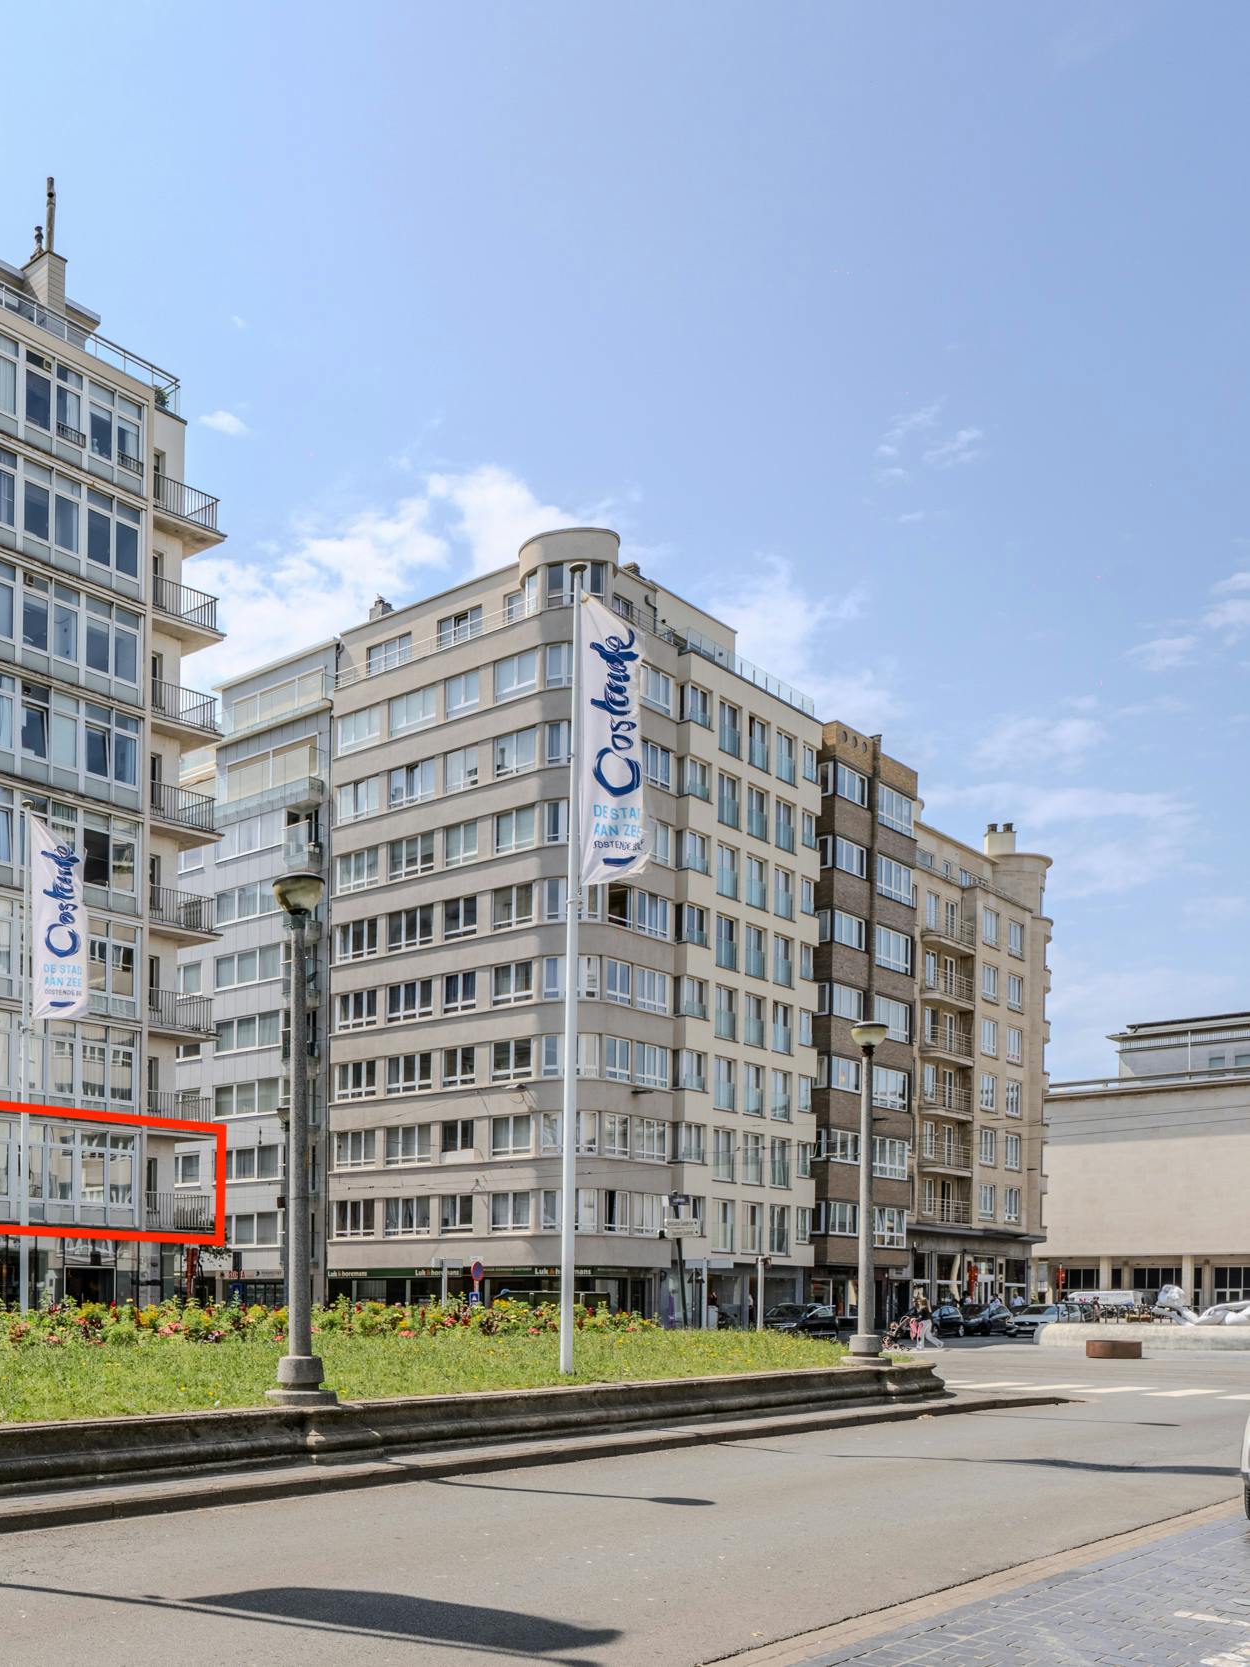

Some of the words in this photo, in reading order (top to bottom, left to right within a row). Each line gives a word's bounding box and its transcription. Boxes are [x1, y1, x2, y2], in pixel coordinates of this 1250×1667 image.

[589, 628, 642, 797] Oostende
[594, 822, 619, 837] AAN
[41, 845, 81, 958] Oostende
[44, 963, 56, 973] DE
[60, 964, 82, 975] STAD
[45, 976, 63, 986] AAN
[67, 977, 82, 987] ZEE
